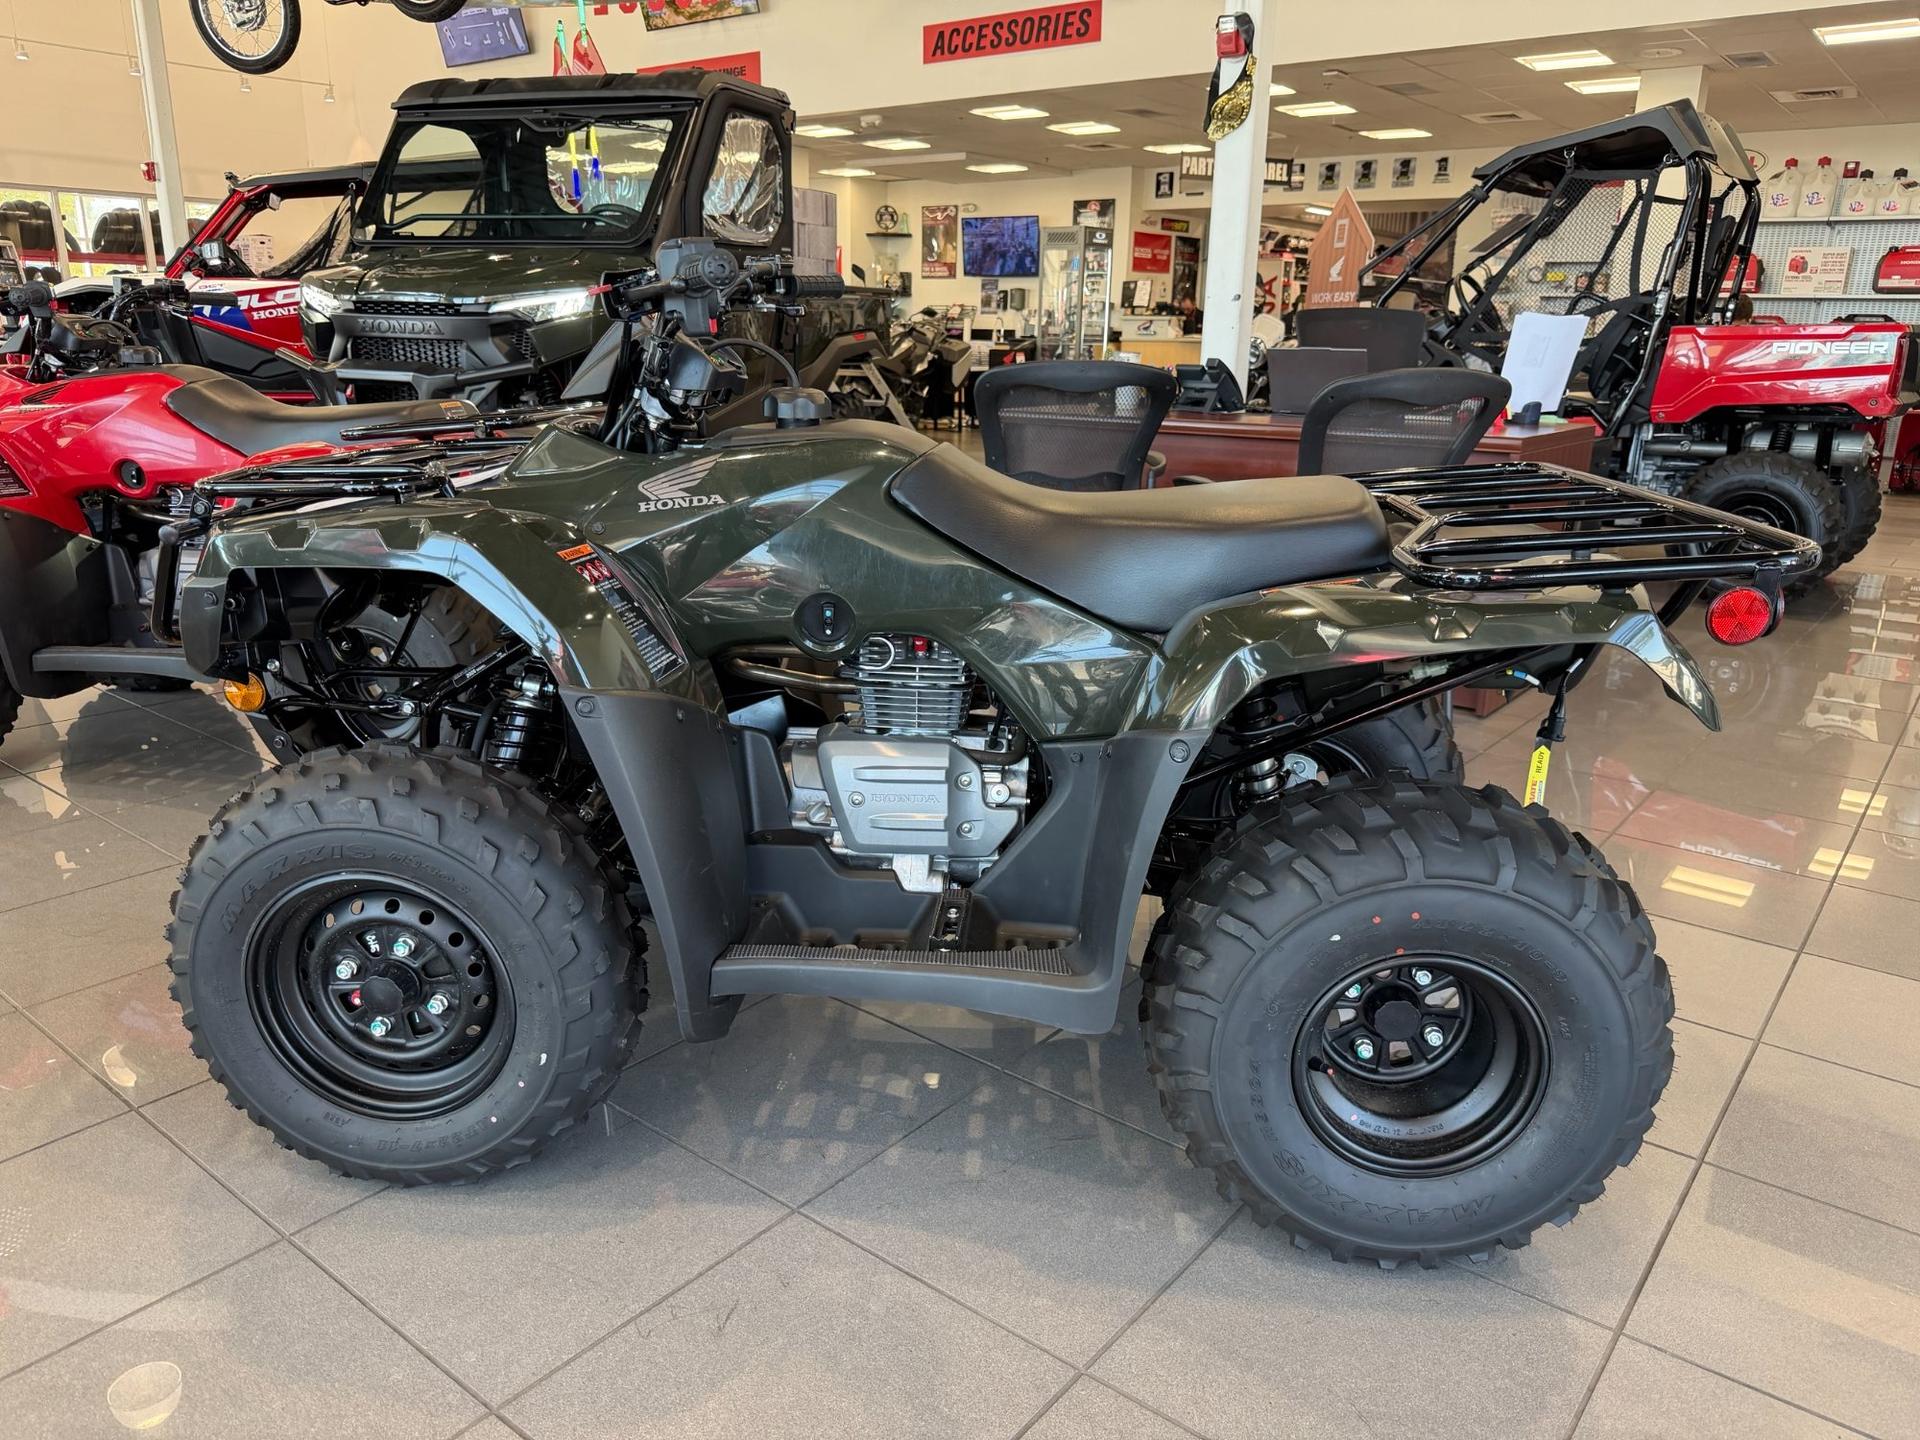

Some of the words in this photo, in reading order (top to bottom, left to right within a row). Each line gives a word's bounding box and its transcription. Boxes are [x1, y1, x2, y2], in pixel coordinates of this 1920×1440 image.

[931, 9, 1092, 57] ACCESSORIES
[1311, 292, 1333, 304] WORK
[1334, 291, 1357, 303] EASY
[251, 306, 299, 320] HOND
[358, 319, 445, 335] HONDA
[1772, 341, 1889, 355] PIONEER
[637, 494, 726, 513] HONDA
[870, 793, 941, 804] HONDA
[219, 843, 376, 933] MAXXIS
[1272, 1149, 1497, 1225] MAXXIS
